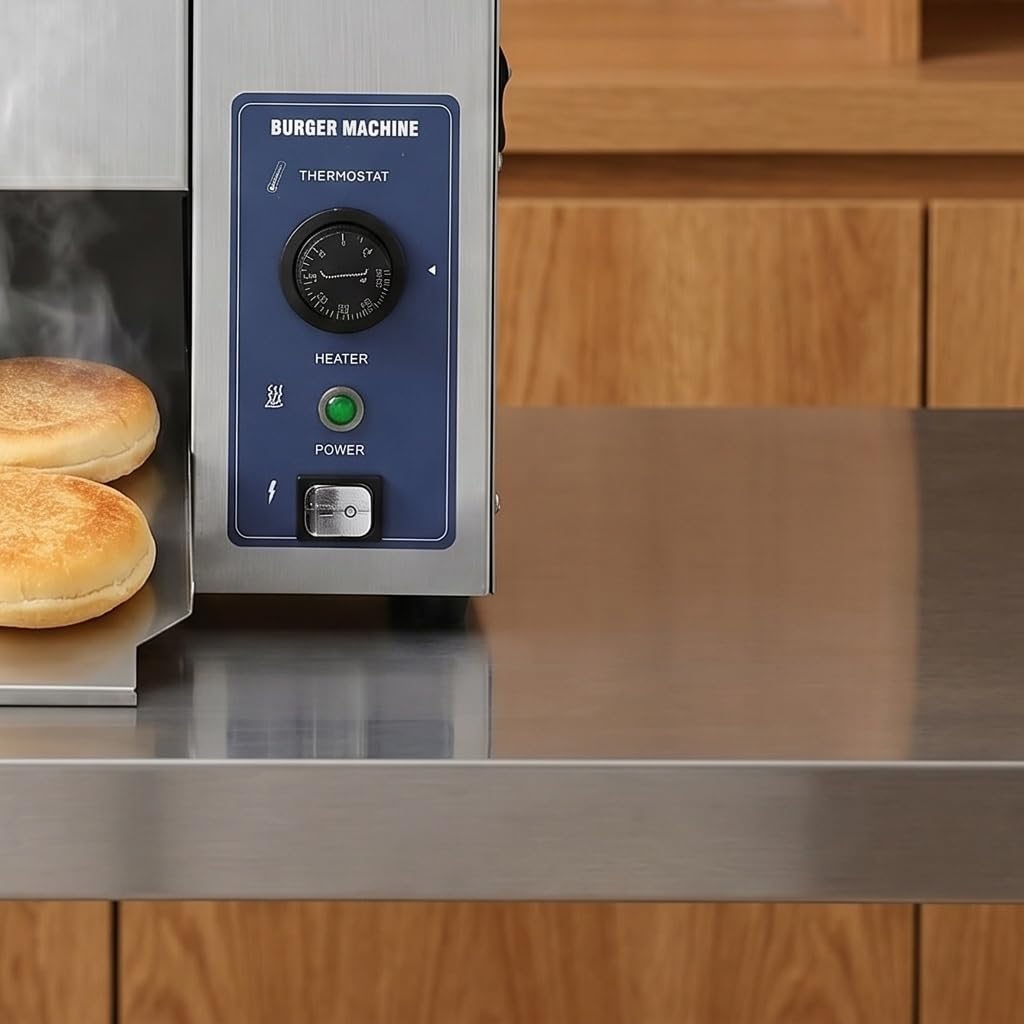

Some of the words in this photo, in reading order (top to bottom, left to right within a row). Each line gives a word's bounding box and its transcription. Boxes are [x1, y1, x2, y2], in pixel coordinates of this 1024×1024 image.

[271, 119, 338, 136] BURGER
[342, 120, 419, 137] MACHINE
[299, 170, 389, 182] THERMOSTAT
[315, 353, 368, 364] HEATER
[315, 444, 365, 455] POWER
